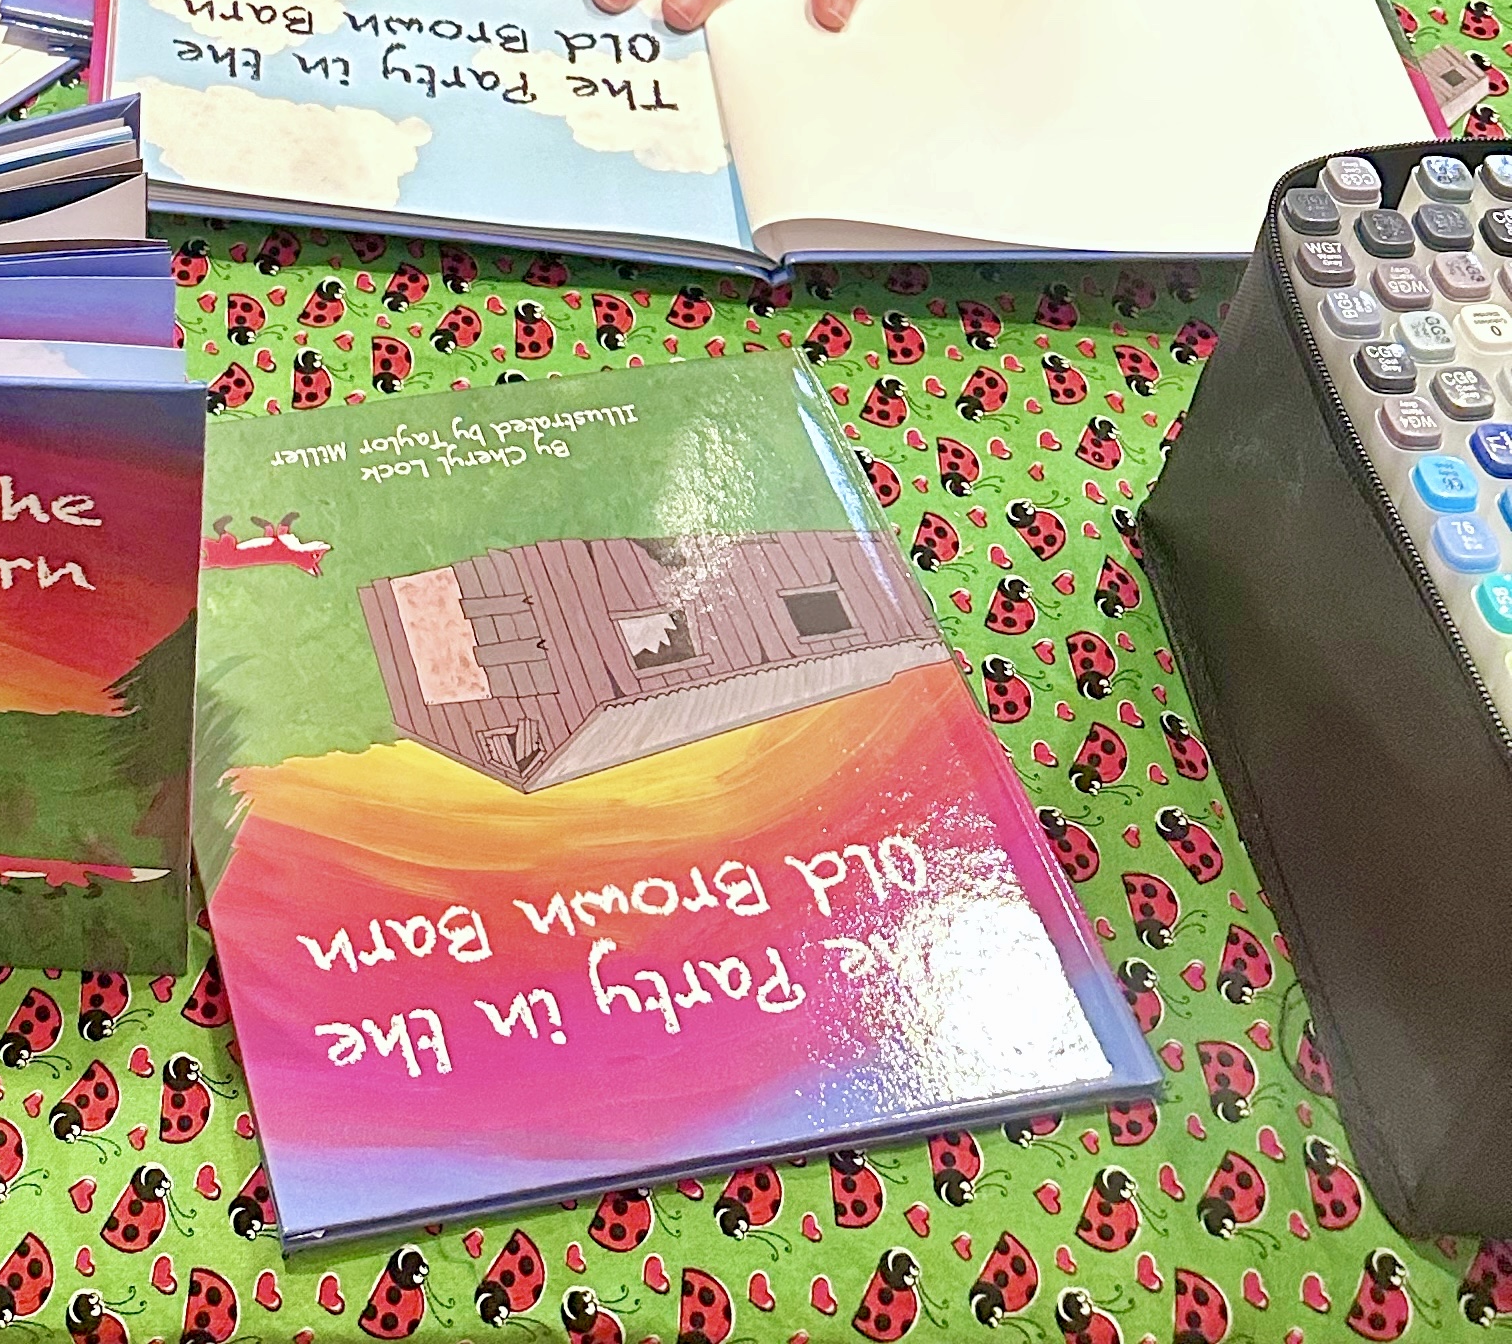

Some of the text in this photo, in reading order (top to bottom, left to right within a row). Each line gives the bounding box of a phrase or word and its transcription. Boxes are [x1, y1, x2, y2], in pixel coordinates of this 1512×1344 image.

[343, 10, 528, 54] Brown
[553, 29, 661, 65] Old
[172, 38, 678, 112] The Party in the
[1303, 241, 1342, 254] WG7
[1388, 280, 1430, 294] WG5
[270, 404, 639, 468] Illustrated by Taylor Miller
[1400, 416, 1438, 429] WG4
[360, 433, 571, 483] By Cheryl Lock
[1451, 521, 1475, 535] 76
[296, 834, 928, 973] Old Brown Barn
[588, 937, 806, 1034] Party
[474, 987, 567, 1045] in
[314, 1008, 454, 1078] the
